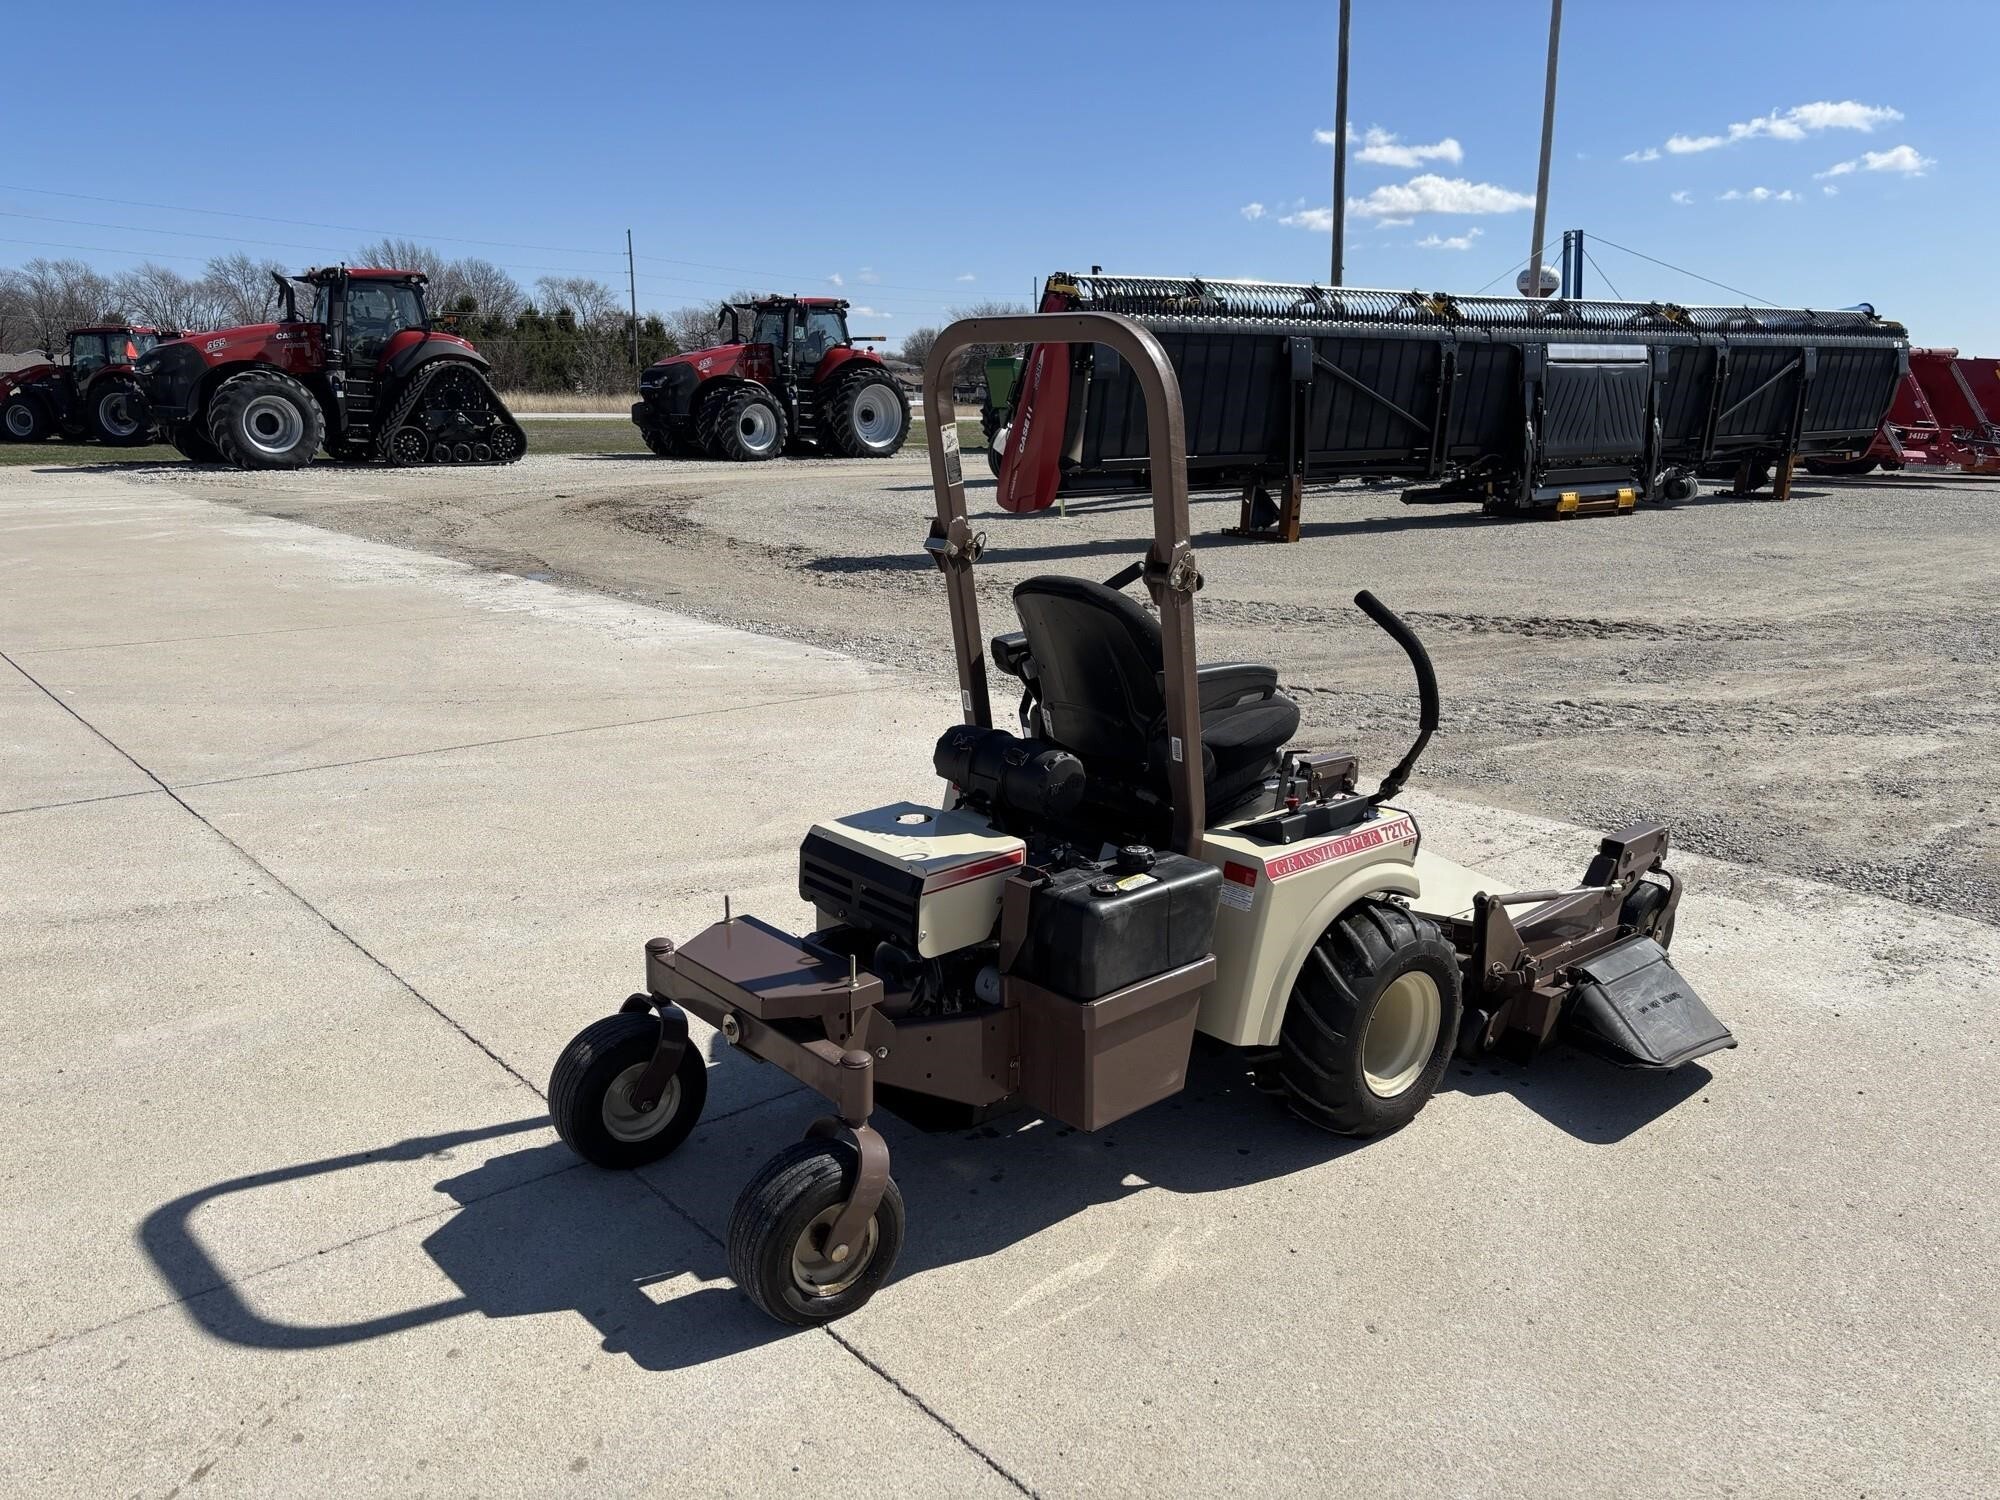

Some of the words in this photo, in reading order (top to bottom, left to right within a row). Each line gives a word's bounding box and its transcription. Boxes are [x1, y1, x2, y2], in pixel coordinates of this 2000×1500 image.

[207, 338, 225, 350] 355
[1018, 418, 1030, 453] CASE
[1908, 432, 1930, 440] 14115
[1275, 831, 1379, 875] GRASSHOPPER
[1381, 819, 1414, 841] 727K
[1403, 837, 1415, 847] EFI
